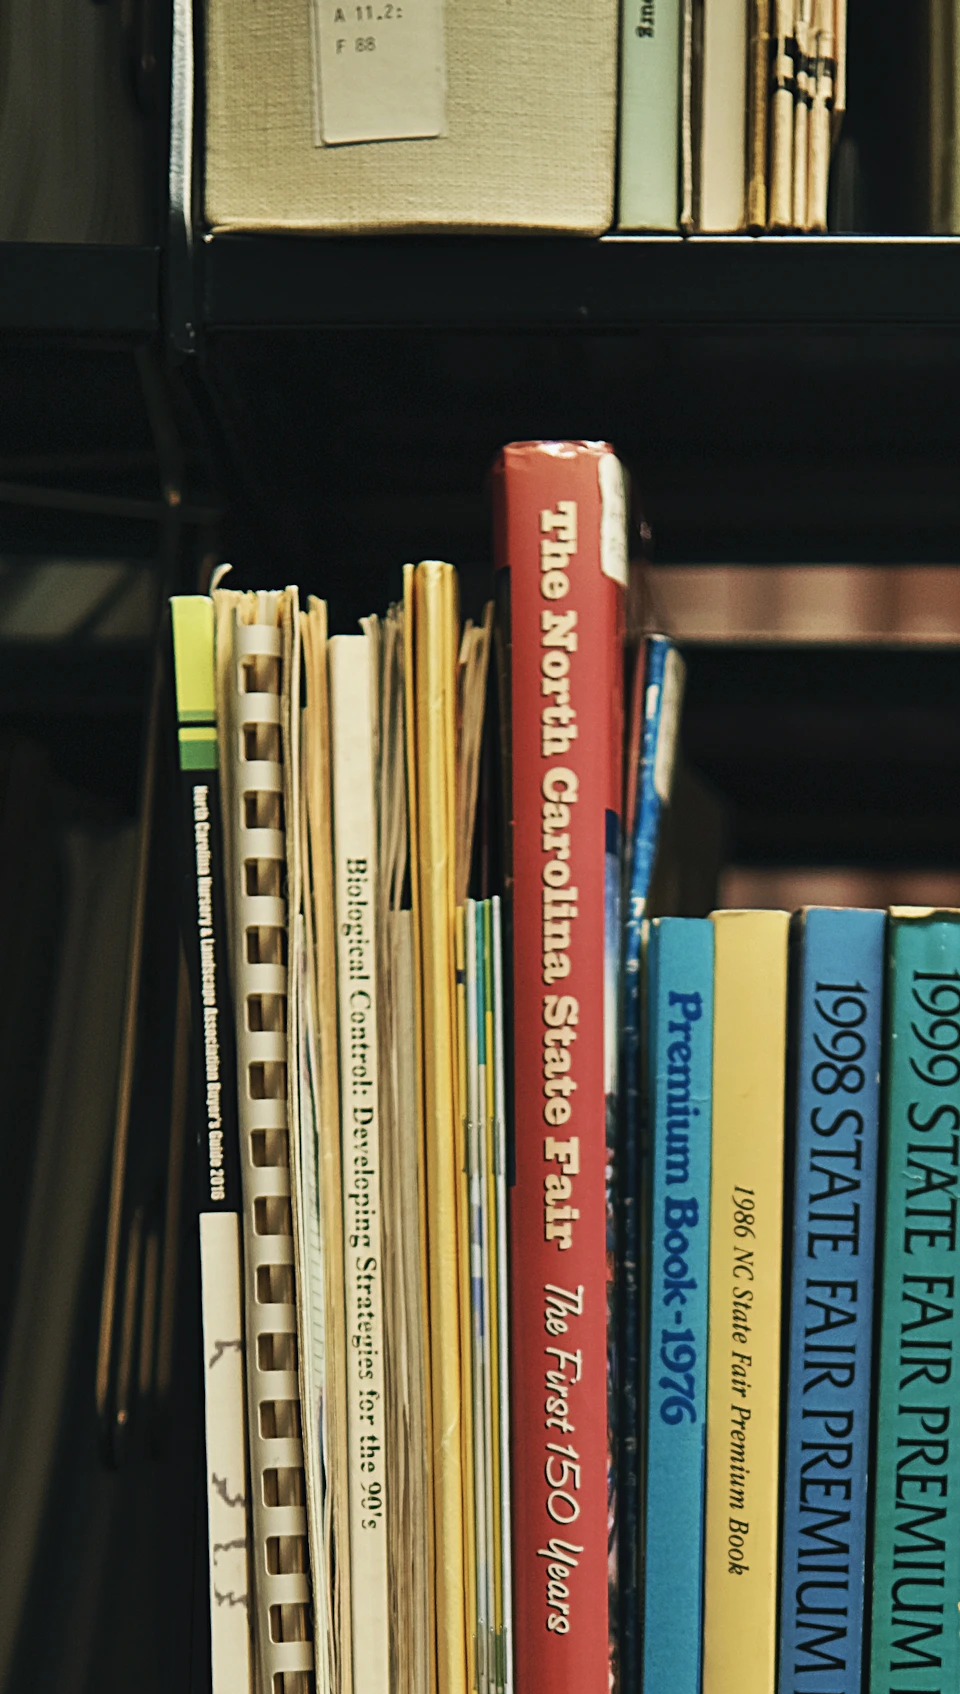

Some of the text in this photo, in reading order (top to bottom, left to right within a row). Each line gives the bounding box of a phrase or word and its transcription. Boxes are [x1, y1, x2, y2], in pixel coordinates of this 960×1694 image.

[334, 8, 346, 22] A
[335, 38, 346, 54] F
[634, 0, 654, 38] urg
[191, 784, 211, 821] North
[193, 822, 213, 876] Carolina
[196, 877, 215, 925] Nursery
[539, 500, 582, 1251] The North Carolina State Fair
[200, 938, 218, 1005] Landscape
[203, 1006, 221, 1081] Association
[810, 980, 869, 1096] 1998
[206, 1081, 224, 1129] Buyer's
[208, 1130, 225, 1167] Guide
[341, 856, 384, 1531] Biological Control: Developing Strategies for the 90's
[659, 989, 702, 1427] Premium Book-1976
[805, 1107, 865, 1260] STATE
[727, 1184, 757, 1577] 1986 NC State Fair Premium Book
[800, 1279, 858, 1394] FAIR
[897, 1273, 955, 1387] FAIR
[538, 1282, 586, 1637] The First 150 Years
[792, 1409, 855, 1674] PREMIUM
[888, 1406, 951, 1672] PREMIUM
